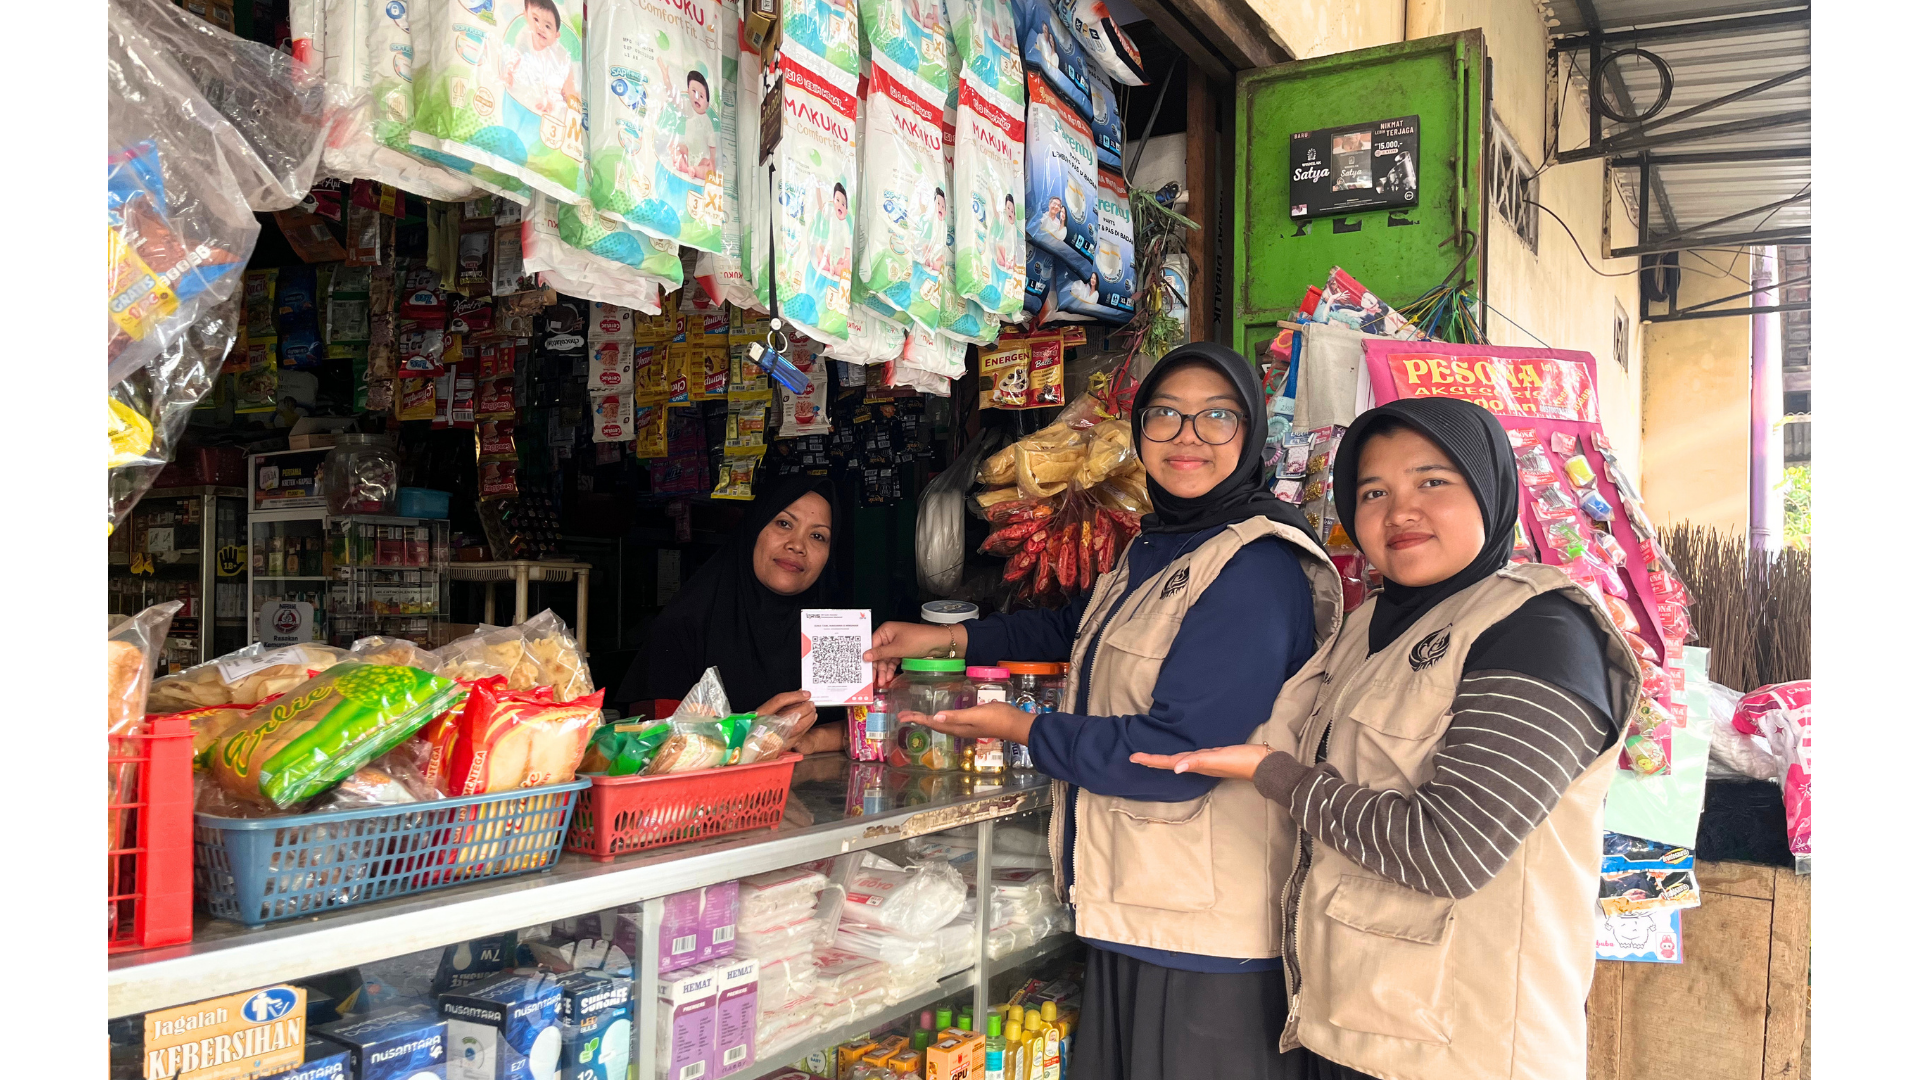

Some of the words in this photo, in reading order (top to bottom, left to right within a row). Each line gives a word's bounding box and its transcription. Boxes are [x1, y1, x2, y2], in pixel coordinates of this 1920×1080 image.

[784, 97, 848, 142] MAKUKU
[1380, 120, 1404, 130] NIKMAT
[550, 125, 557, 138] 3
[796, 123, 832, 147] Comfort
[1386, 126, 1414, 137] TERJAGA
[1293, 166, 1331, 183] Satya
[1341, 169, 1362, 179] Satya
[1097, 199, 1130, 223] renty
[112, 275, 156, 313] GRATIS
[985, 352, 1030, 368] ENERGEN
[1403, 358, 1545, 389] PESONA
[727, 965, 754, 980] HEMAT
[683, 978, 712, 994] HEMAT
[445, 1003, 502, 1021] NUSANTARA
[514, 993, 562, 1019] NUSANTARA
[153, 1008, 229, 1041] Jagalah
[148, 1017, 302, 1080] KEBERSIHAN
[371, 1035, 442, 1064] NUSANTARA
[511, 1058, 526, 1072] E27
